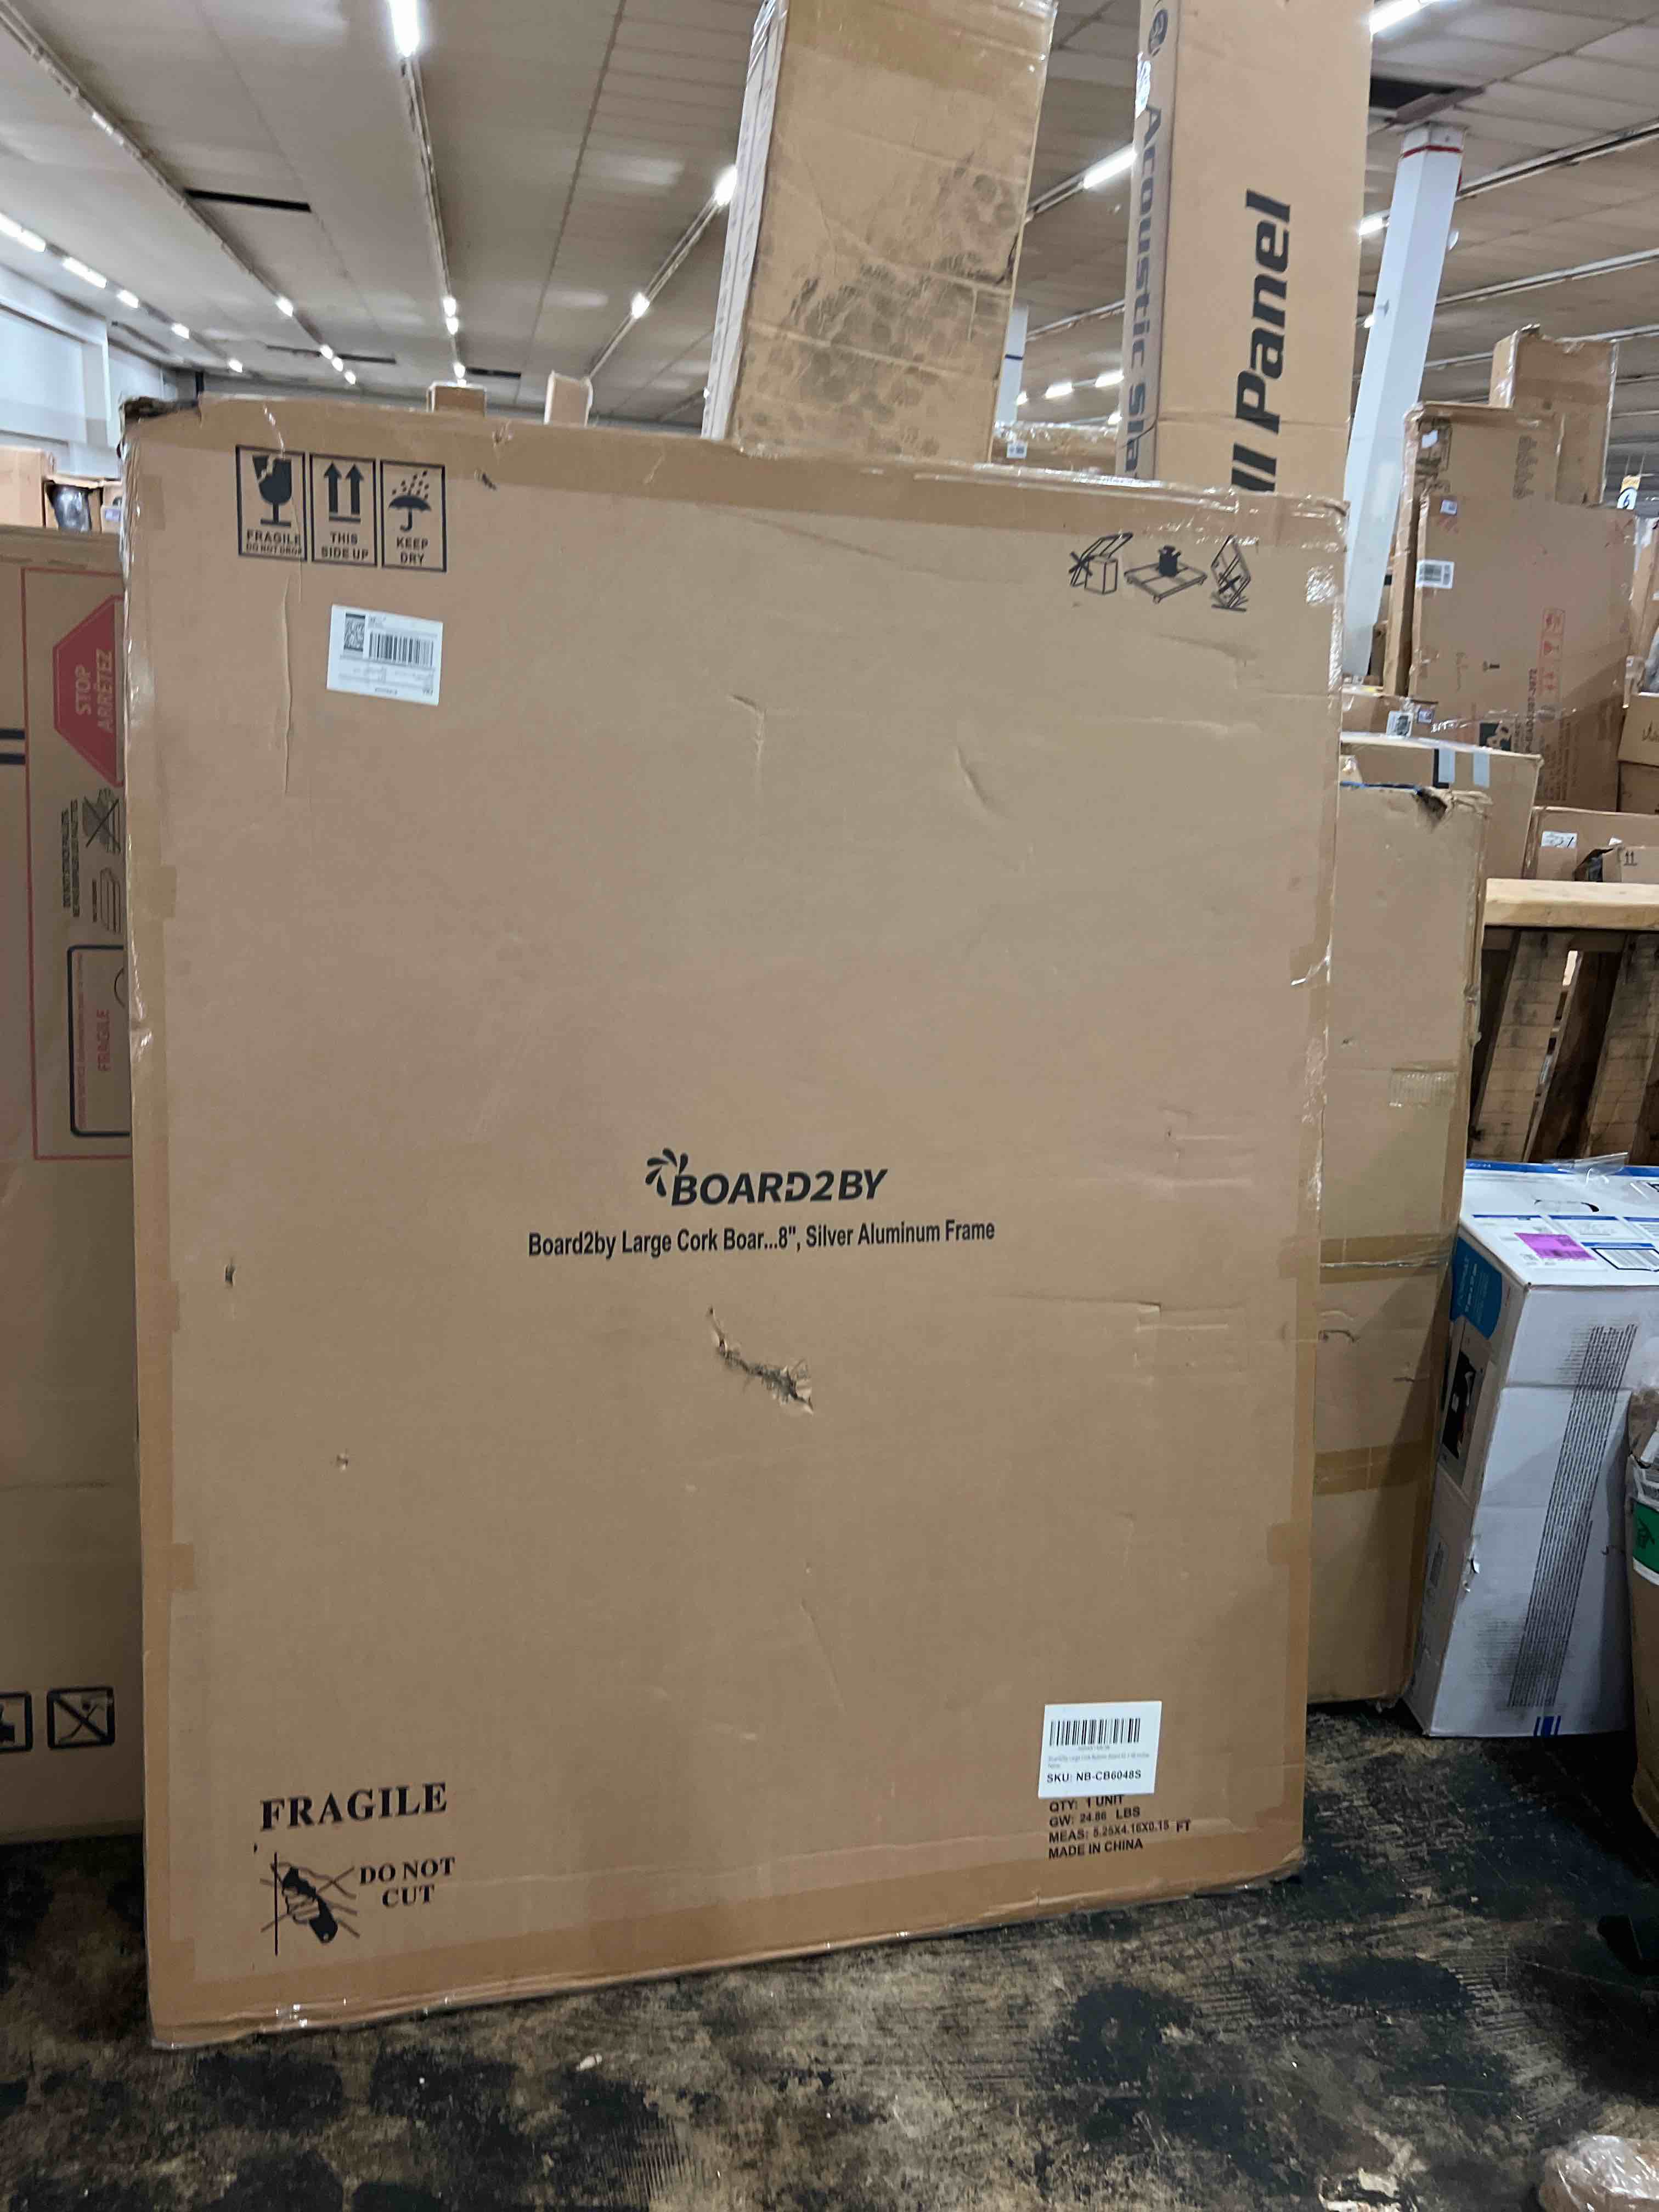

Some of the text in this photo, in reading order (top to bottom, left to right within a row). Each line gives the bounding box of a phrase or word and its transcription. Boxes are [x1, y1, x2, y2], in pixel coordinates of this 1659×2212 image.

[1125, 105, 1162, 479] Acoustic Sla
[1235, 189, 1291, 435] Panel
[246, 530, 301, 546] FRAGILE
[330, 531, 358, 545] THIS
[396, 536, 428, 551] KEEP
[321, 546, 368, 561] SIDE UP
[400, 552, 425, 566] DRY
[75, 664, 92, 716] STOP
[97, 1008, 111, 1072] FRAGILE
[671, 1168, 888, 1206] BOARD2BY
[528, 1231, 615, 1260] Board2by
[622, 1229, 672, 1258] Large
[678, 1228, 718, 1252] Cork
[806, 1224, 854, 1248] Silver
[857, 1221, 941, 1246] Aluminum
[945, 1218, 995, 1242] Frame
[1047, 1769, 1141, 1784] SKU: NB-CB6048S
[259, 1781, 448, 1832] FRAGILE
[1049, 1800, 1078, 1813] QTY:
[1096, 1794, 1124, 1807] UNIT
[1049, 1815, 1074, 1828] GW:
[1115, 1806, 1141, 1820] LBS
[1049, 1830, 1088, 1844] MEAS:
[1176, 1819, 1191, 1832] FT
[1048, 1838, 1144, 1860] MADE IN CHINA
[359, 1857, 455, 1886] DO NOT
[382, 1883, 435, 1908] CUT
